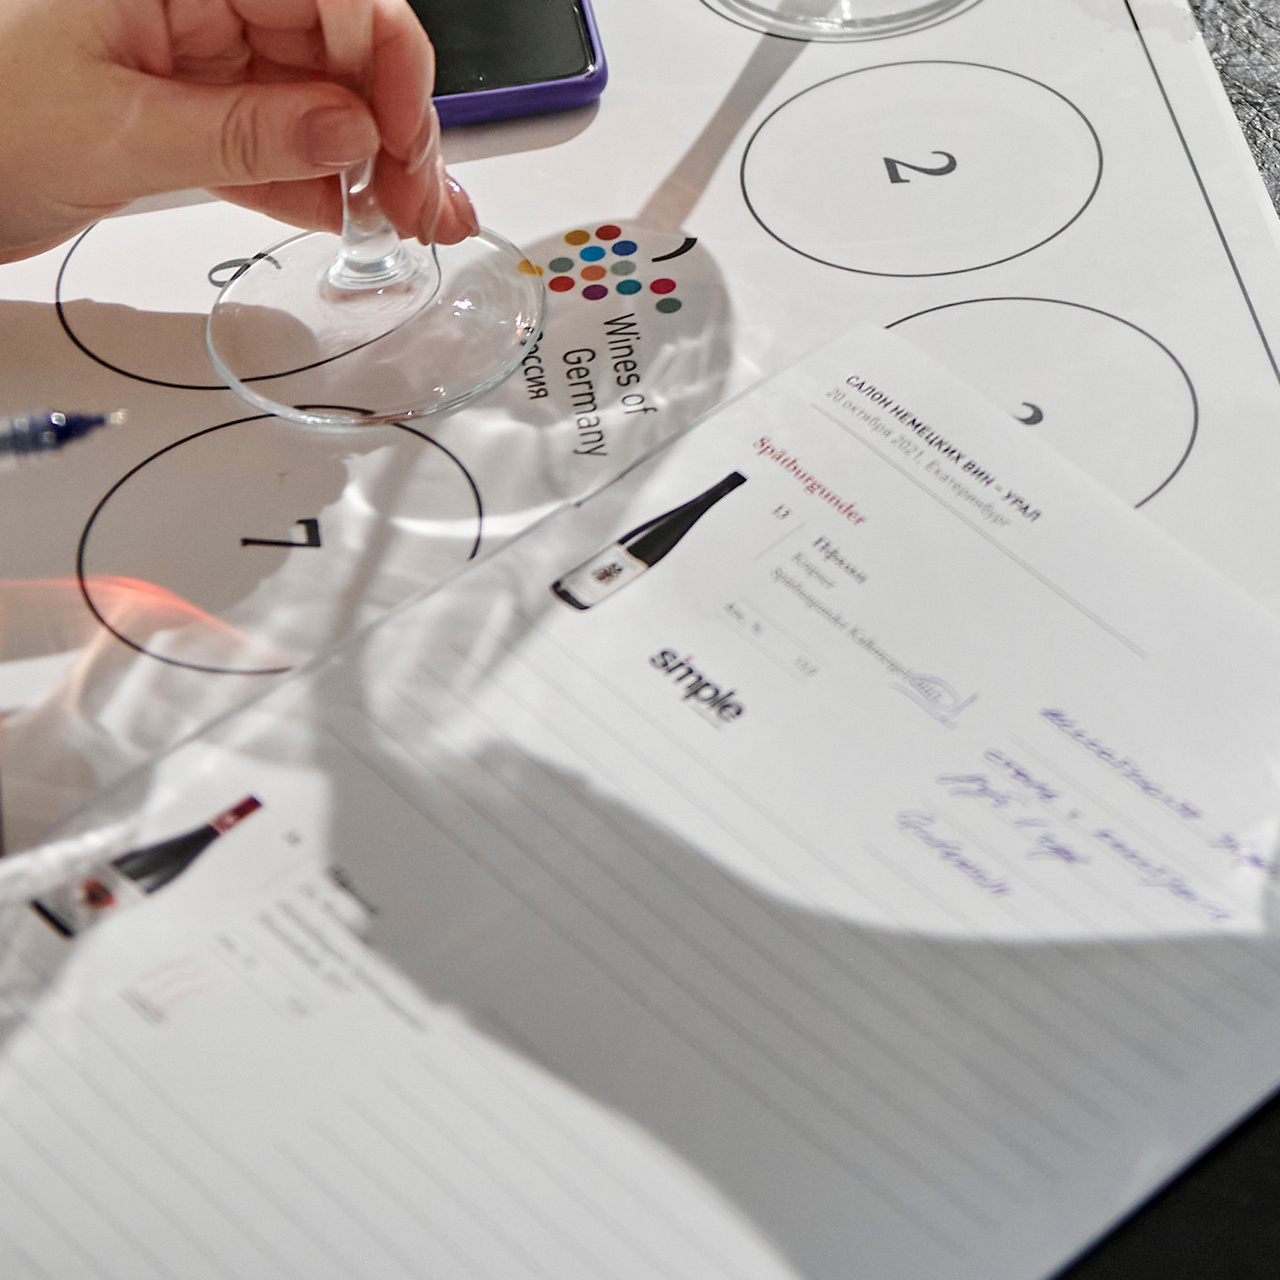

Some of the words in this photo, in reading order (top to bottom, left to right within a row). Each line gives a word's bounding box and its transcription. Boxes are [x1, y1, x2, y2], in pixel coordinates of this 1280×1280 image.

[883, 150, 958, 185] 2
[603, 312, 642, 388] Wines
[562, 347, 609, 457] Germany
[621, 393, 658, 415] of
[826, 386, 846, 404] 20
[753, 435, 868, 526] Spätburgunder
[846, 374, 893, 410] САЛОН
[890, 405, 966, 465] НЕМЕЦКИХ
[962, 460, 996, 488] ВИН
[1001, 489, 1042, 523] УРАЛ
[240, 517, 322, 548] 7
[648, 647, 746, 724] simple
